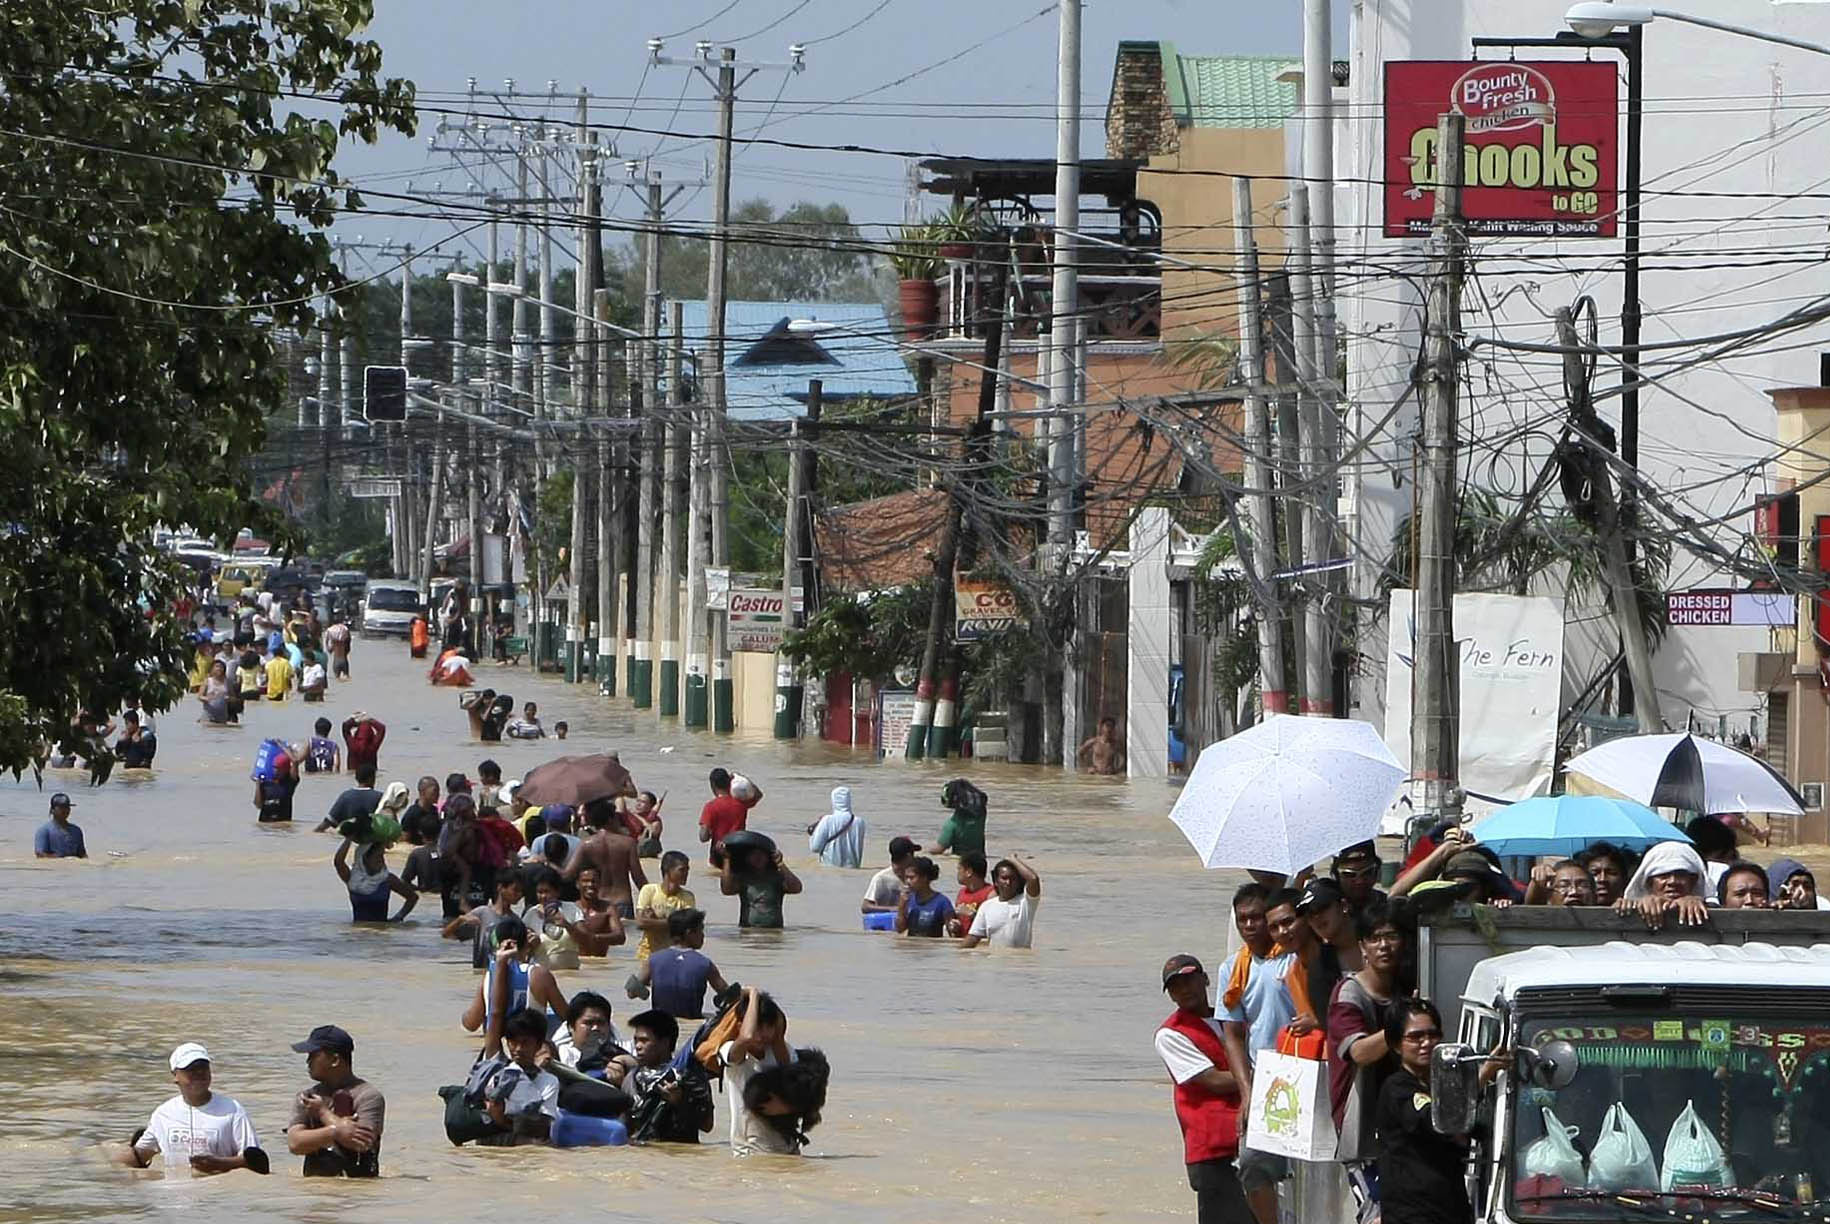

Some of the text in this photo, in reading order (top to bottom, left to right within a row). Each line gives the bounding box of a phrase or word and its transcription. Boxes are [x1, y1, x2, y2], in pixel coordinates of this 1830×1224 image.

[1463, 71, 1528, 104] Bounty
[1552, 194, 1568, 211] to
[1668, 595, 1730, 609] DRESSED
[1669, 609, 1731, 624] CHICKEN
[1502, 639, 1554, 667] Fern
